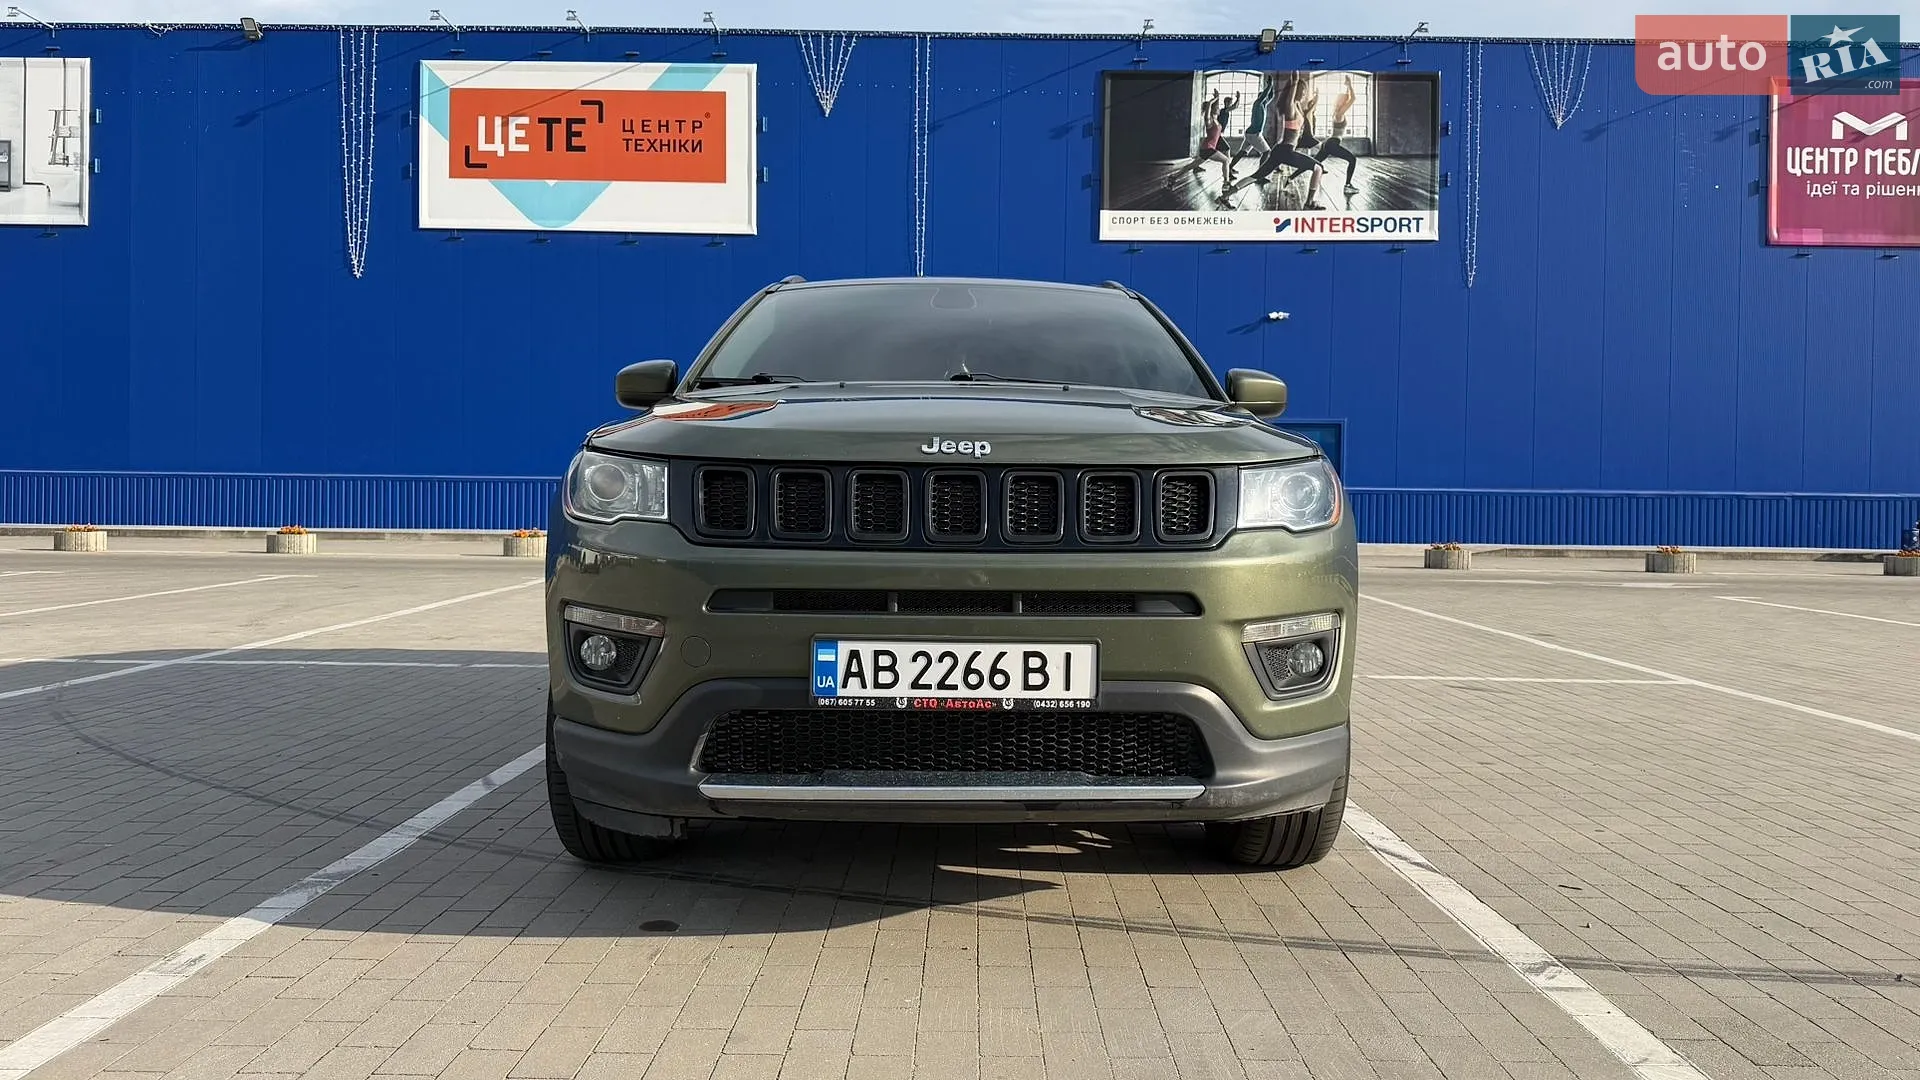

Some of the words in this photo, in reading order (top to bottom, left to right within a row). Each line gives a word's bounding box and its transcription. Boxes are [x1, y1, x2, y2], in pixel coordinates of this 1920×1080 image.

[622, 119, 703, 135] ЦЕНТР
[477, 115, 530, 157] ЦЕ
[537, 117, 587, 152] ТЕ
[622, 138, 703, 153] ТЕХНІКИ
[1786, 146, 1859, 177] ЦЕНТР
[1806, 180, 1838, 198] ідеї
[1842, 184, 1860, 196] та
[1111, 216, 1146, 225] СПОРТ
[1149, 216, 1169, 225] БЕЗ
[1173, 216, 1234, 225] ОБМЕЖЕНЬ
[1294, 216, 1424, 234] INTERSPORT
[921, 436, 992, 459] Jeep
[841, 649, 900, 690] AB
[910, 650, 1012, 691] 2266
[817, 676, 835, 688] UA
[818, 698, 837, 707] (067)
[838, 698, 853, 707] 605
[854, 698, 865, 707] 77
[866, 699, 876, 707] 55
[913, 699, 938, 709] СТО
[1033, 699, 1058, 709] (0432)
[1059, 700, 1075, 708] 656
[1076, 700, 1091, 708] 190
